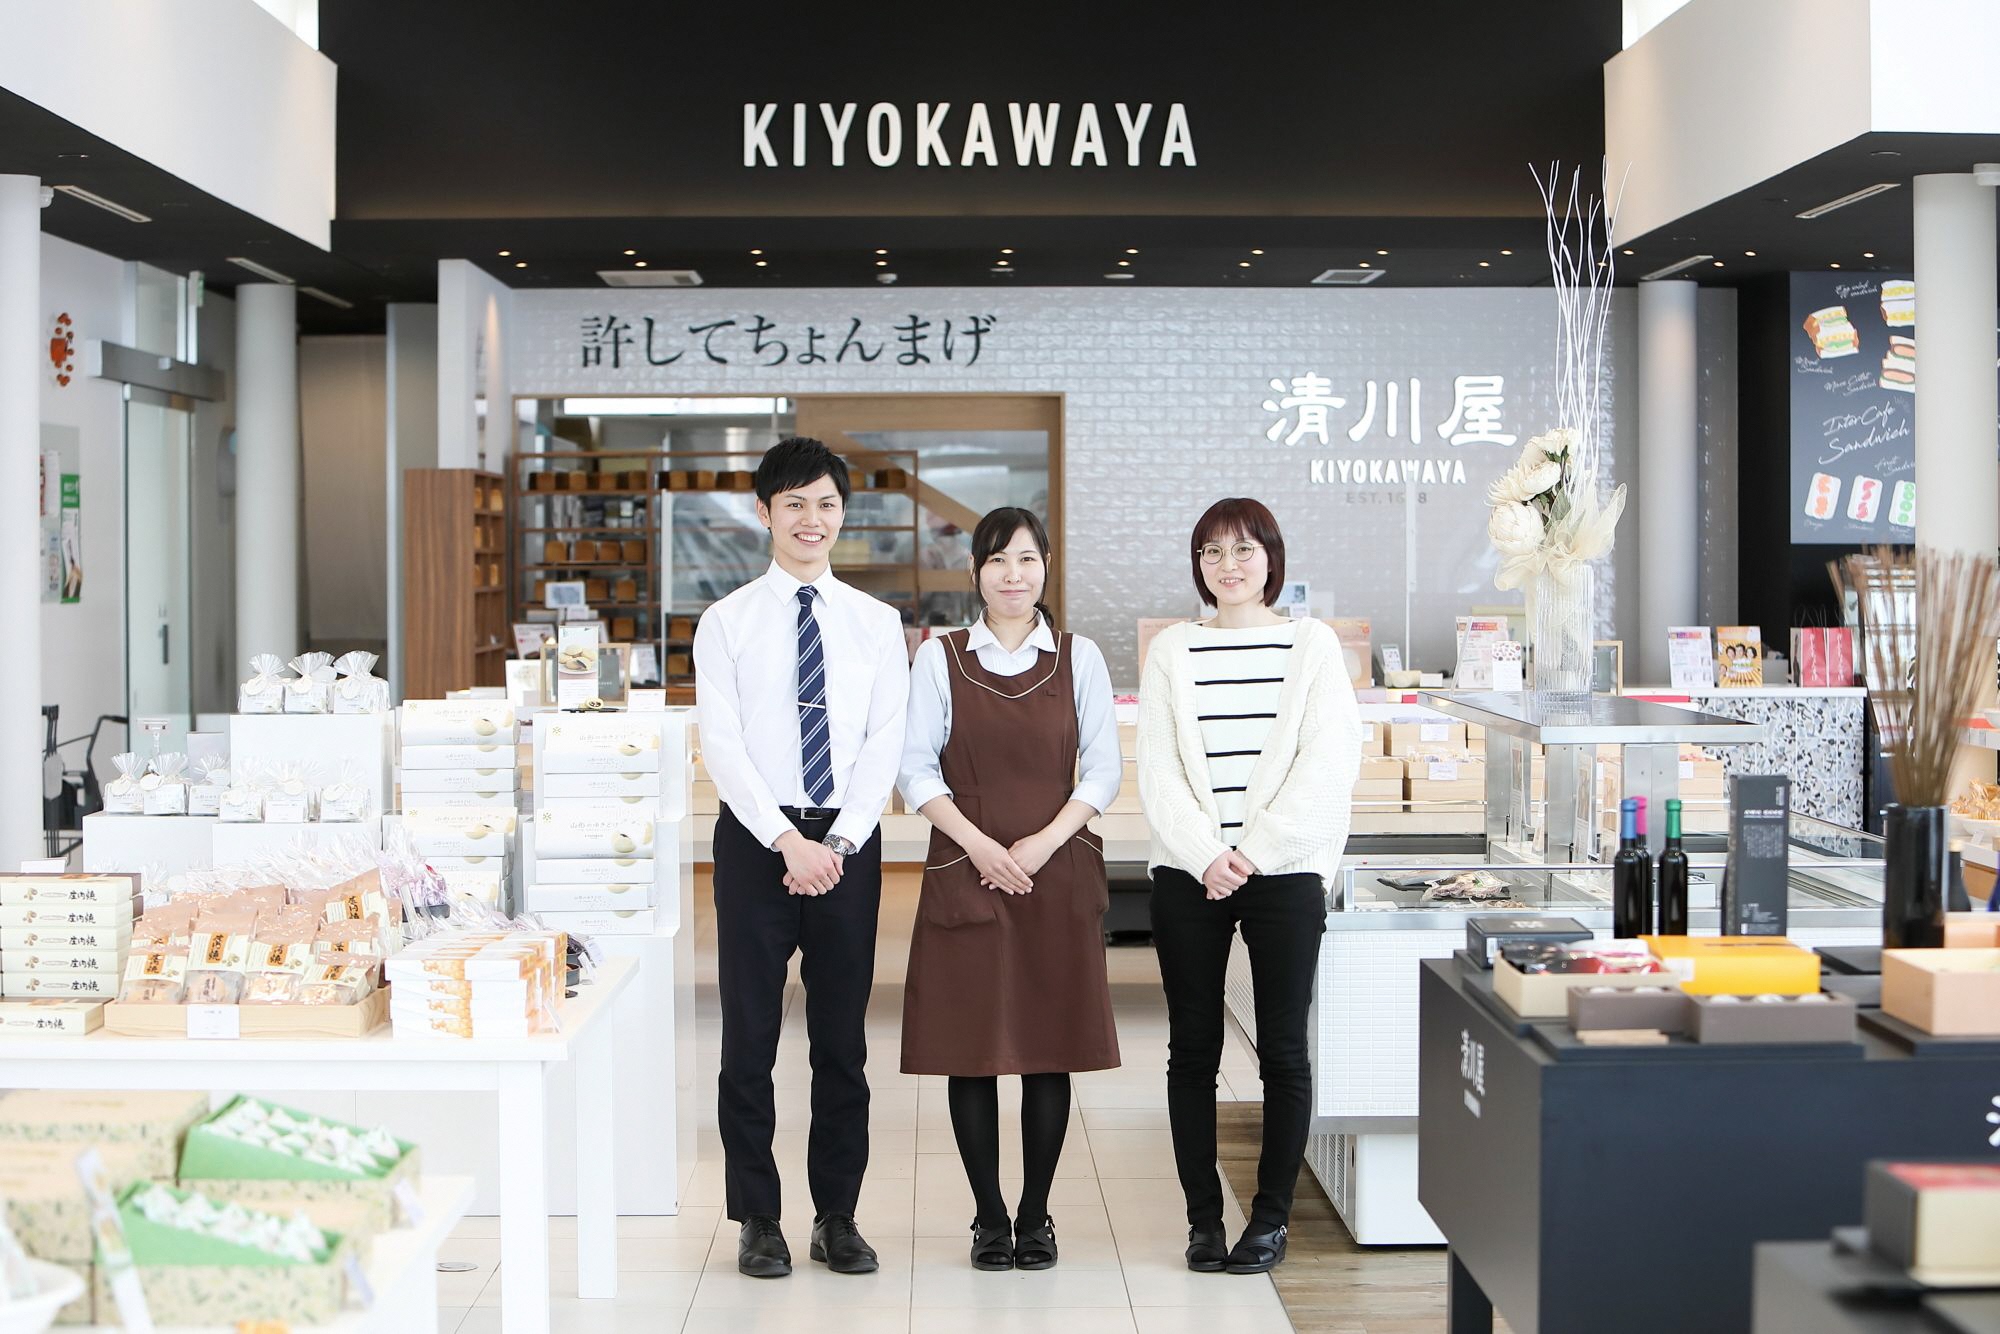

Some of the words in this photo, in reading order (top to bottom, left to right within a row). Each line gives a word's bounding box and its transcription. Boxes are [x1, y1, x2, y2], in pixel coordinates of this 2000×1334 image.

[743, 103, 1197, 167] KIYOKAWAYA
[582, 314, 997, 369] 許してちょんまげ
[1262, 371, 1517, 447] 清川屋
[1818, 418, 1910, 465] Sandwich
[1310, 459, 1467, 484] KIYOKAWAYA
